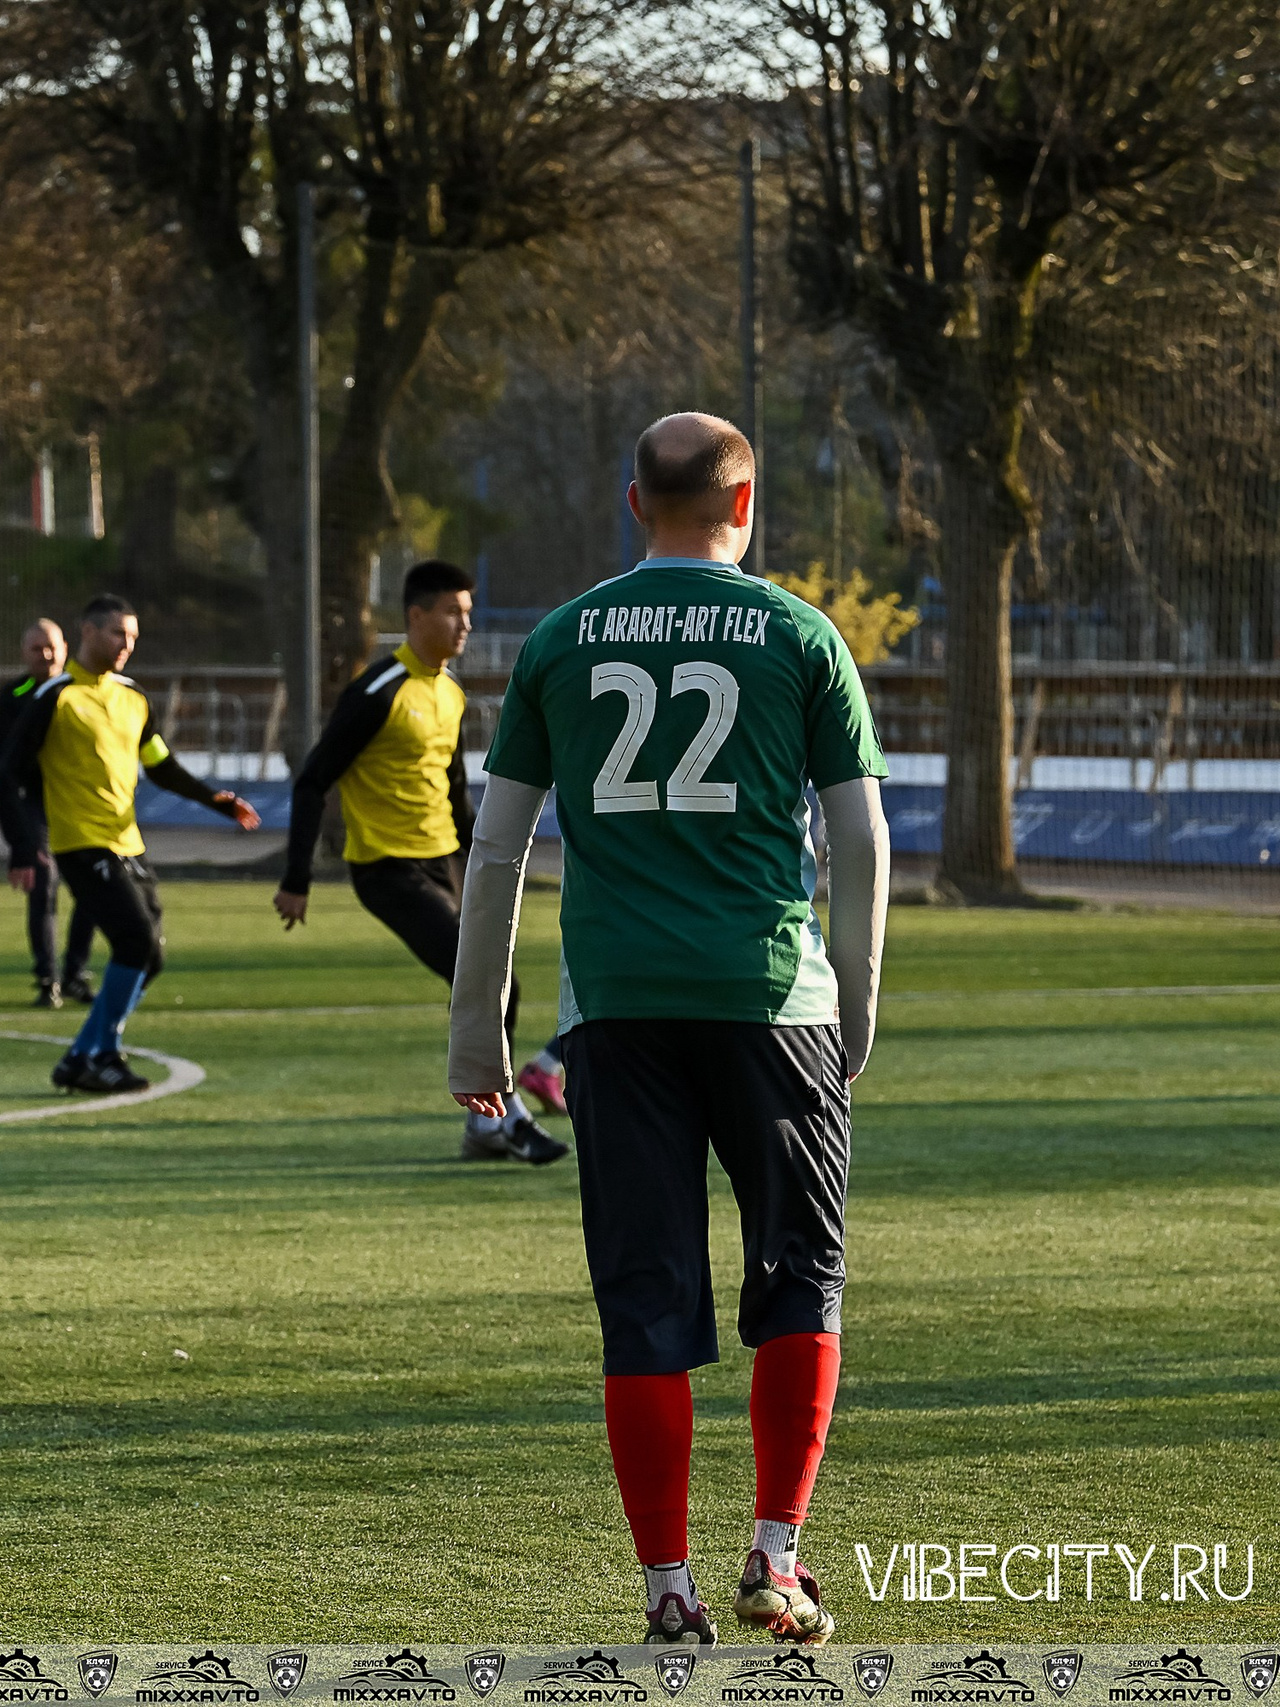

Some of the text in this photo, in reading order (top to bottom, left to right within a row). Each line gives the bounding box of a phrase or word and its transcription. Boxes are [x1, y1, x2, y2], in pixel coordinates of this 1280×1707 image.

[577, 606, 771, 646] FC ARARAT-ART FLEX
[590, 661, 740, 814] 22
